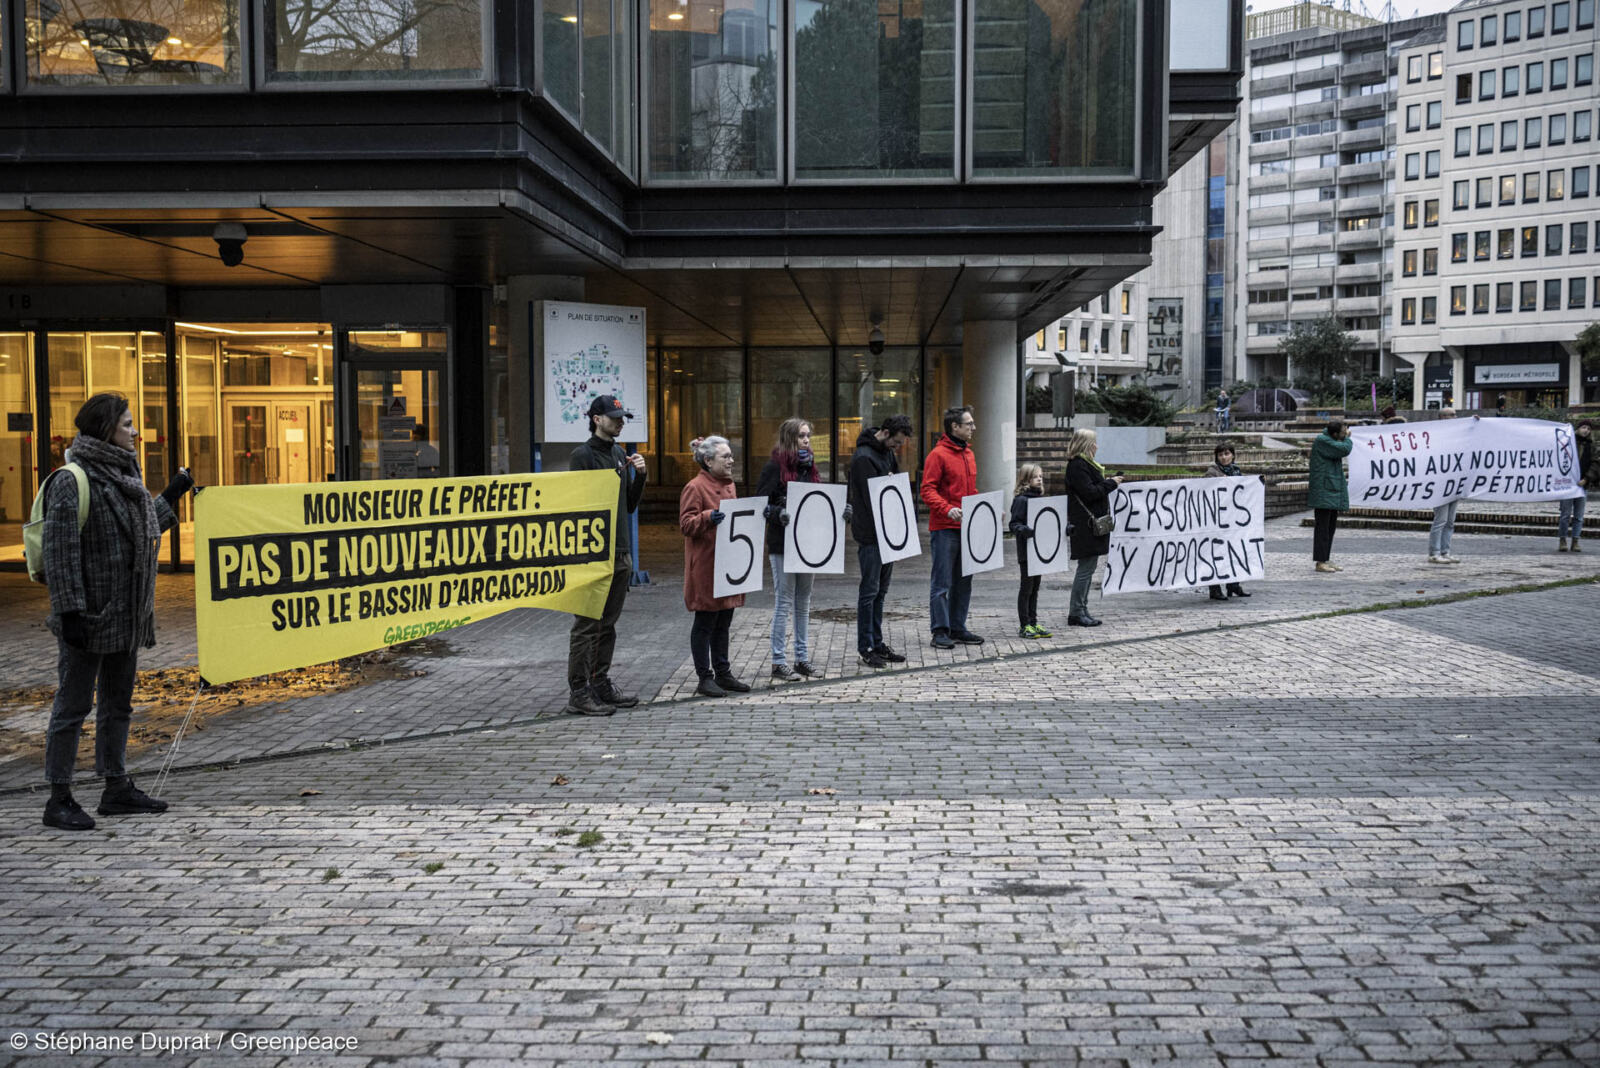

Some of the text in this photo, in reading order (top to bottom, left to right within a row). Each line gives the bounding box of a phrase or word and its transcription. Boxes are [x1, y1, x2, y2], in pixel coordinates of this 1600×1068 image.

[22, 294, 31, 310] B
[568, 312, 584, 321] PLAN
[584, 313, 592, 321] DE
[594, 314, 624, 323] SITUATION
[1363, 470, 1552, 501] PUITS DE PÉTROLE
[1370, 457, 1416, 480] NON
[1425, 452, 1464, 475] AUX
[1470, 449, 1553, 472] NOUVEAUX
[304, 489, 422, 525] MONSIEUR
[429, 486, 455, 516] LE
[794, 490, 837, 568] 0
[879, 485, 909, 551] 0
[1113, 484, 1252, 532] PERSONNES
[217, 517, 606, 589] PAS DE NOUVEAUX FORAGES
[726, 509, 755, 586] 5
[967, 500, 997, 564] 0
[1033, 506, 1062, 564] 0
[1147, 537, 1265, 587] OPPOSENT
[271, 595, 320, 632] SUR
[328, 592, 352, 624] LE
[359, 582, 432, 620] BASSIN
